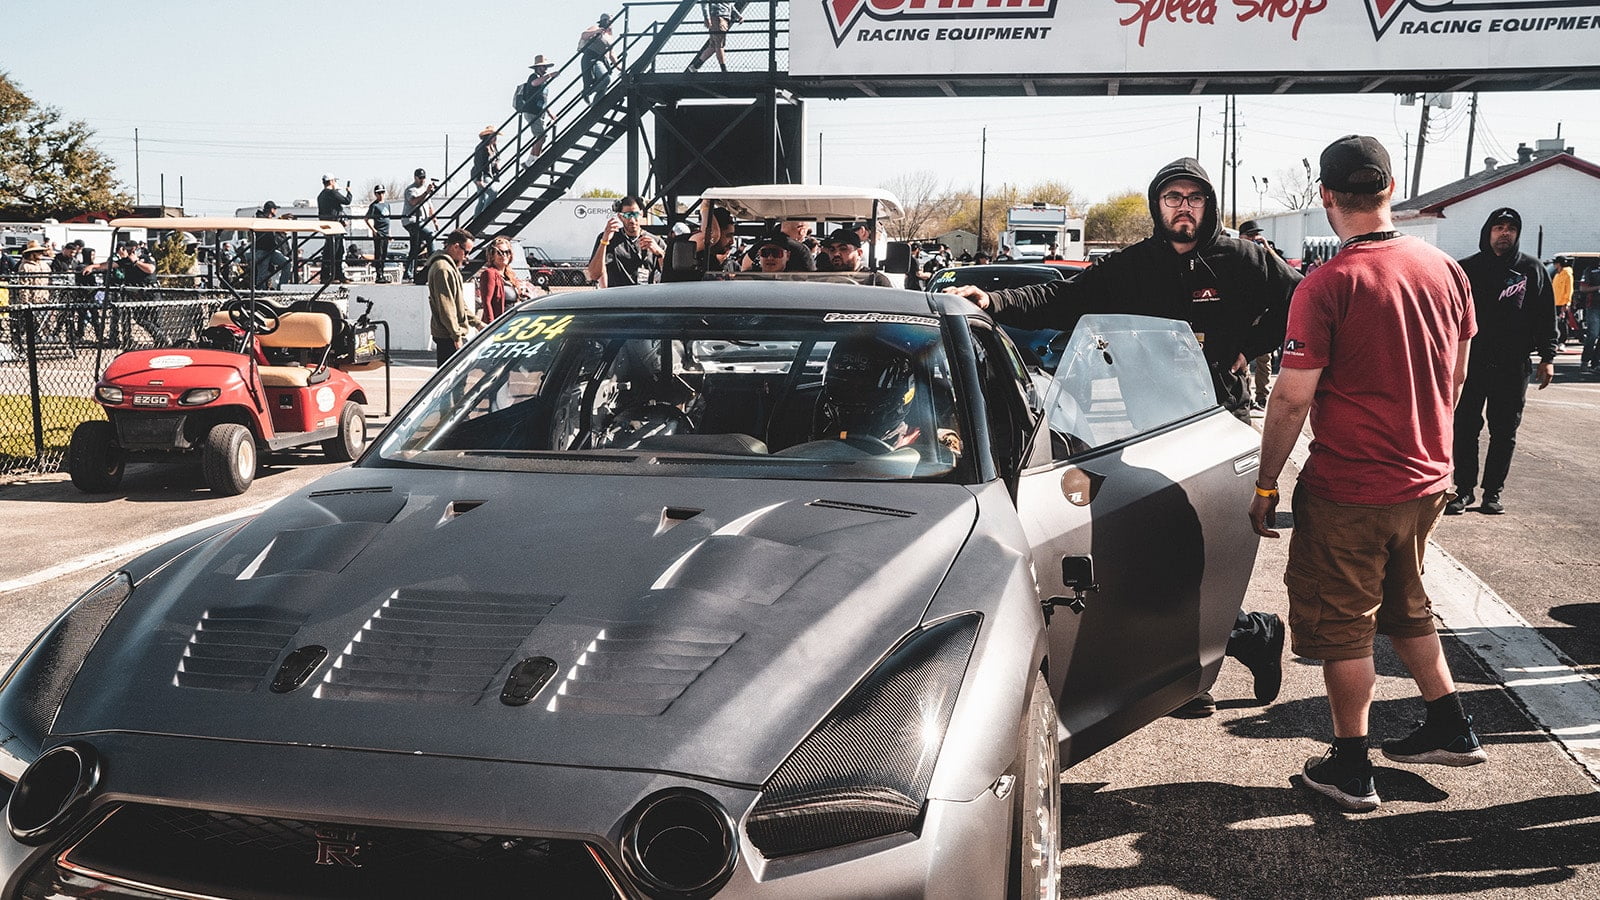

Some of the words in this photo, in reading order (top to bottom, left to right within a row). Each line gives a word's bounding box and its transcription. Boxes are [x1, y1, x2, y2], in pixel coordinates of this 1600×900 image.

[856, 28, 930, 42] RACING
[935, 27, 1052, 41] EQUIPMENT
[1399, 20, 1482, 34] RACING
[587, 207, 616, 215] GERHO
[493, 314, 576, 342] 354
[477, 341, 546, 360] GTR4
